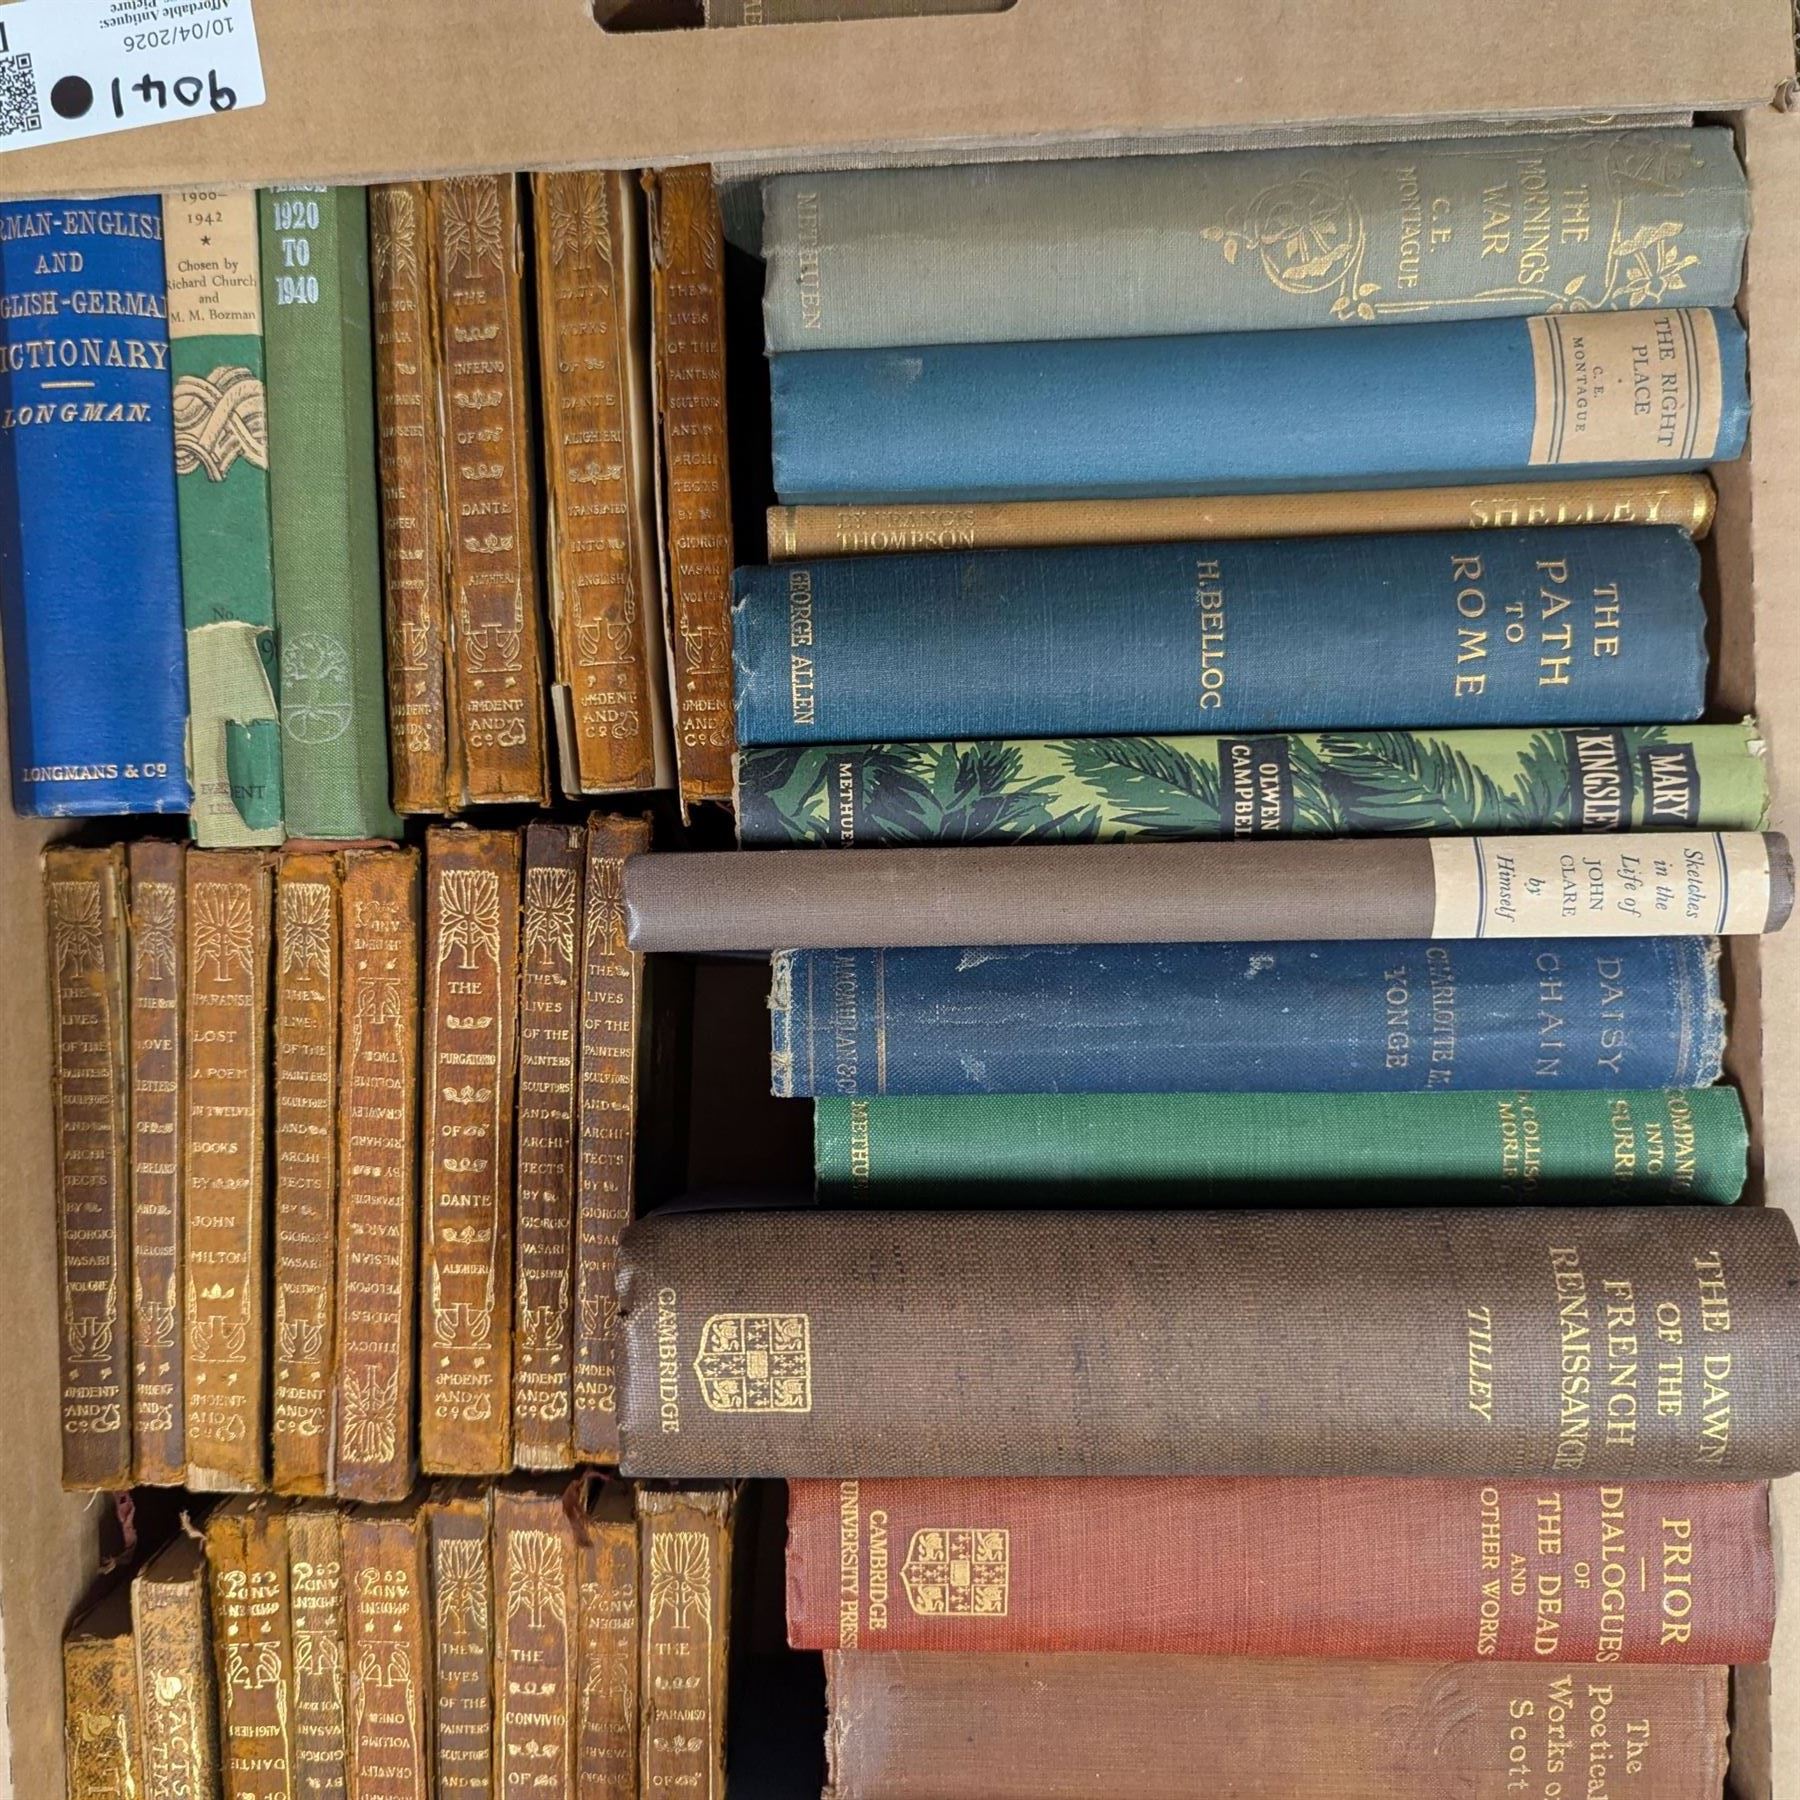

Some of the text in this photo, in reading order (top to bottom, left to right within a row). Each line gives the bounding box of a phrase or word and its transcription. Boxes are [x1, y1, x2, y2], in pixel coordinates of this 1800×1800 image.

[99, 0, 230, 29] Affordable Antiques:
[123, 17, 234, 52] 10/04/2026
[112, 69, 237, 118] 9041
[188, 212, 223, 226] 1942
[274, 202, 319, 230] 1920
[1398, 167, 1421, 289] MONTAGUE
[1481, 181, 1511, 259] WAR
[1562, 184, 1589, 243] THE
[34, 251, 83, 274] AND
[178, 258, 239, 273] Chosen by
[282, 239, 310, 267] TO
[199, 292, 219, 304] and
[276, 276, 319, 306] 1940
[171, 309, 256, 323] M. M. Bozman
[454, 360, 505, 374] INFERNO
[1573, 337, 1588, 432] MONTAGUE
[1592, 366, 1604, 398] C. E.
[1632, 345, 1651, 415] PLACE
[1654, 317, 1677, 447] THE RIGHT
[2, 402, 151, 429] LONGMAN.
[461, 503, 511, 516] DANTE
[1469, 490, 1672, 528] SHELLEY
[836, 529, 976, 551] THOMPSON
[1451, 554, 1487, 697] ROME
[1505, 601, 1524, 642] TO
[1536, 559, 1571, 685] PATH
[1594, 583, 1619, 656] THE
[790, 570, 814, 725] GEORGE ALLEN
[23, 765, 118, 782] LONGMANS
[124, 765, 139, 779] &
[1231, 745, 1254, 838] CAMPBEL
[1649, 752, 1689, 820] MARY
[1259, 763, 1280, 831] OLWEN
[1494, 854, 1515, 923] Himself
[1526, 876, 1547, 896] by
[1560, 854, 1576, 917] CLARE
[1583, 858, 1602, 911] JOHN
[1617, 854, 1642, 918] Life of
[1653, 859, 1675, 911] in the
[1684, 847, 1708, 919] Sketches
[449, 982, 482, 994] THE
[589, 964, 614, 977] THE
[587, 991, 624, 1004] LIVES
[1425, 947, 1455, 1063] CHARLOTTE
[1536, 952, 1566, 1077] CHAIN
[1596, 957, 1626, 1074] DAISY
[194, 1030, 237, 1043] LOST
[523, 1029, 569, 1041] OF THE
[585, 1019, 630, 1032] OF THE
[1384, 966, 1409, 1069] YONGE
[440, 1053, 496, 1065] PURGATORIO
[523, 1055, 571, 1067] PAINTERS
[584, 1045, 631, 1058] PAINTERS
[442, 1125, 460, 1137] OF
[522, 1108, 550, 1120] AND
[521, 1161, 565, 1174] TECTS
[583, 1152, 624, 1165] TECTS
[1644, 1122, 1664, 1176] INTO
[440, 1194, 492, 1207] DANTE
[522, 1190, 539, 1200] BY
[582, 1207, 629, 1219] GIORGIO
[191, 1216, 235, 1228] JOHN
[191, 1251, 248, 1263] MILTON
[657, 1287, 680, 1433] CAMBRIDGE
[1467, 1306, 1492, 1423] TILLEY
[1550, 1248, 1591, 1470] RENAISSANCE
[1603, 1279, 1637, 1446] FRENCH
[1655, 1302, 1682, 1416] OF THE
[1694, 1251, 1731, 1463] THE DAWN
[840, 1481, 859, 1649] UNIVERSITY PRESS
[868, 1510, 888, 1630] CAMBRIDGE
[1477, 1487, 1500, 1656] OTHER WORKS
[1511, 1553, 1526, 1596] AND
[1534, 1492, 1562, 1655] THE DEAD
[1574, 1562, 1590, 1590] OF
[1596, 1487, 1625, 1663] DIALOGUES
[1660, 1517, 1692, 1646] PRIOR
[511, 1650, 544, 1662] THE
[441, 1672, 479, 1682] LIVES
[440, 1697, 487, 1708] OF THE
[506, 1712, 565, 1725] CONVIVIO
[656, 1709, 706, 1721] PARADISO
[440, 1723, 489, 1734] PAINTERS
[1508, 1700, 1535, 1791] Scott
[1545, 1674, 1574, 1800] Works o
[1626, 1719, 1650, 1774] The
[169, 1709, 191, 1797] ACTS
[508, 1773, 531, 1784] OF
